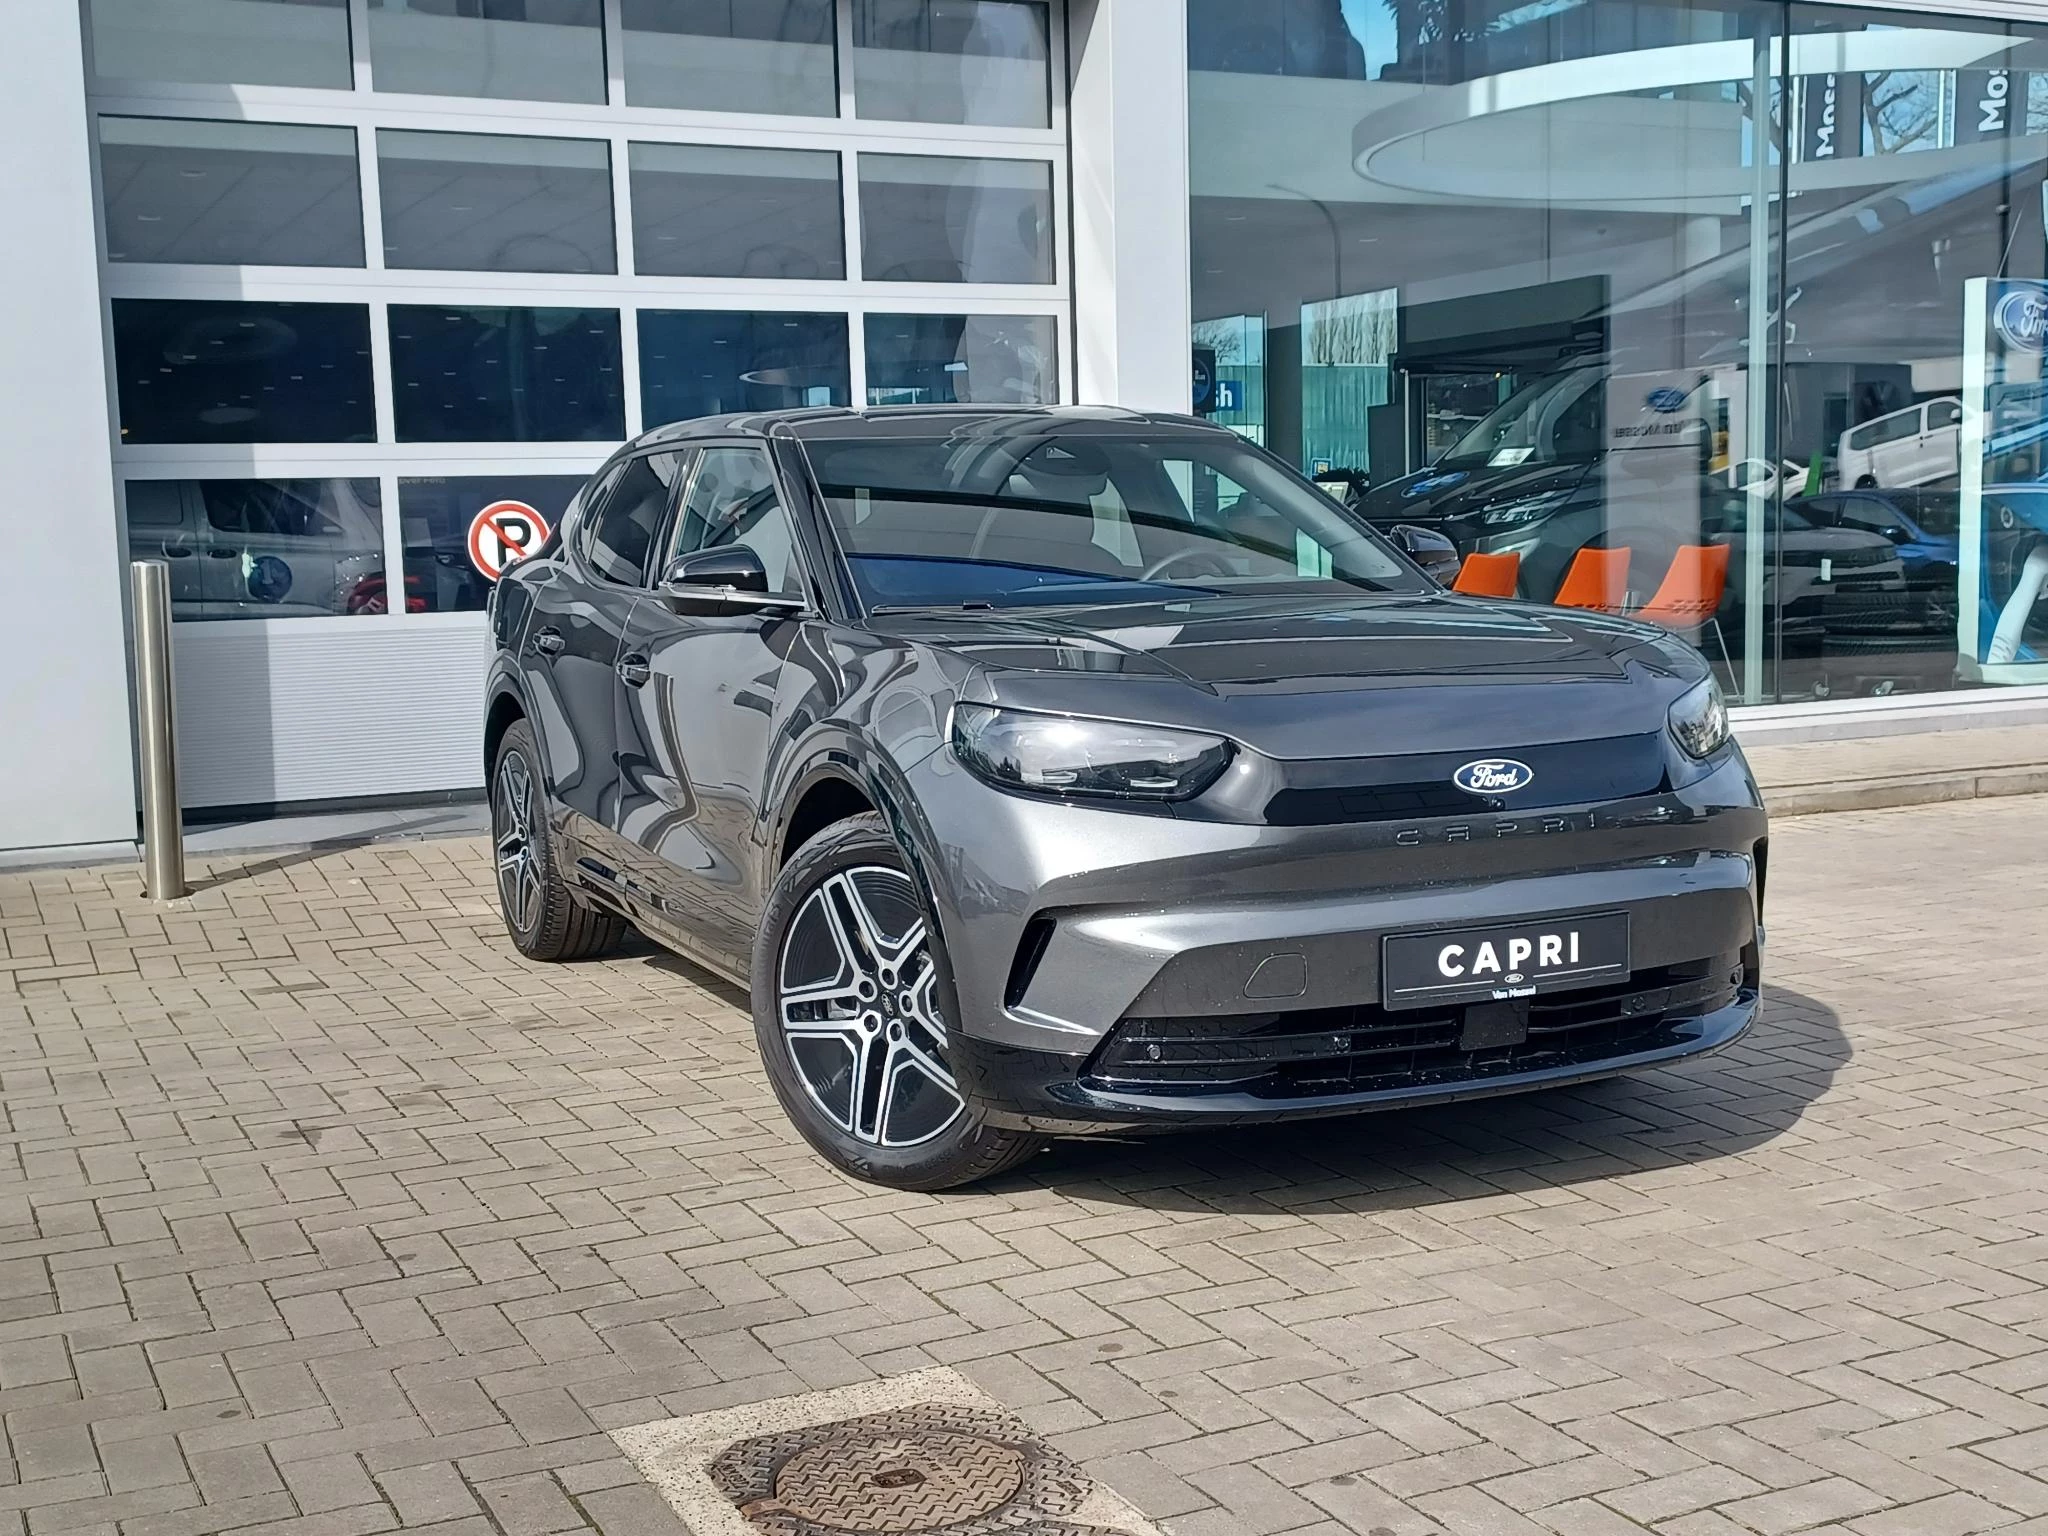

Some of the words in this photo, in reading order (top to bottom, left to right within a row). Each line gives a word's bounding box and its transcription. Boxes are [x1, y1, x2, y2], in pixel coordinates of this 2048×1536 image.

[1470, 764, 1518, 788] Ford
[1396, 812, 1596, 846] CAPRI
[1437, 931, 1580, 978] CAPRI
